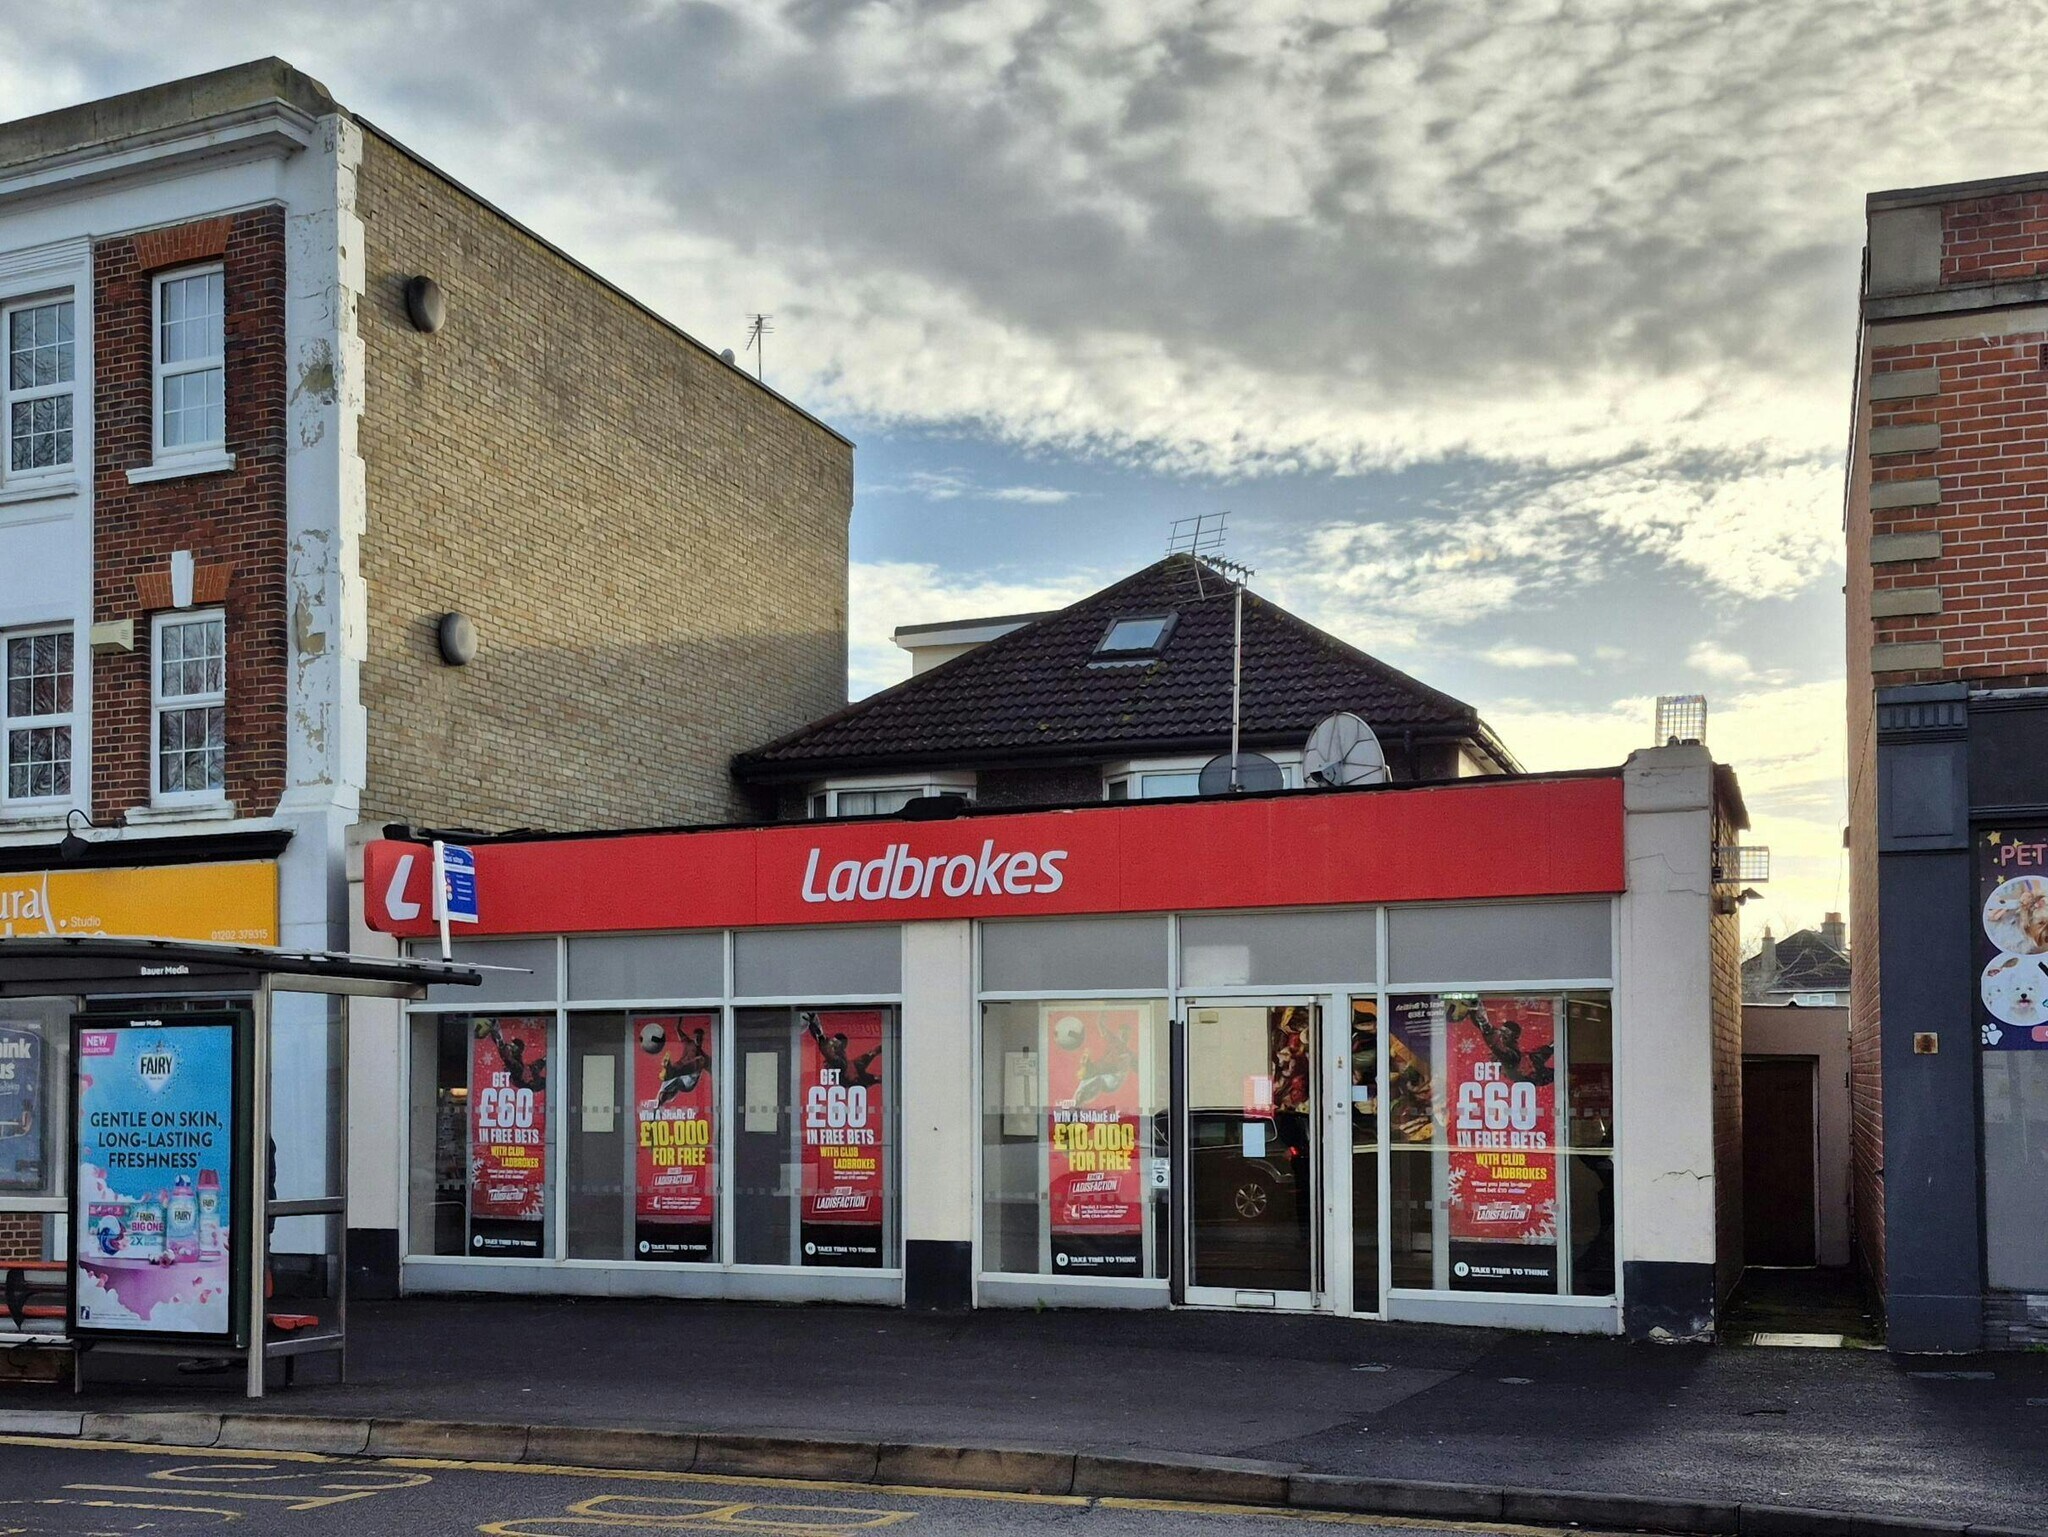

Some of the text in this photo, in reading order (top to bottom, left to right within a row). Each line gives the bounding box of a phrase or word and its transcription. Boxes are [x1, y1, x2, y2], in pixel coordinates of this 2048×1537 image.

[2001, 844, 2048, 866] PET
[801, 839, 1068, 903] Ladbrokes
[385, 855, 421, 920] L
[71, 915, 101, 928] Studio
[211, 930, 236, 940] 01202
[141, 965, 189, 976] Bauer Media
[0, 1038, 32, 1059] ink
[86, 1036, 108, 1046] NEW
[140, 1056, 172, 1075] FAIRY
[1474, 1062, 1502, 1081] GET
[492, 1071, 511, 1088] GET
[820, 1068, 841, 1086] GET
[479, 1087, 534, 1128] £60
[806, 1086, 867, 1128] £60
[1457, 1081, 1537, 1130] £60
[90, 1111, 223, 1131] GENTLE ON SKIN,
[1054, 1110, 1070, 1123] WIN
[1072, 1111, 1079, 1123] A
[98, 1132, 213, 1148] LONG-LASTING
[479, 1128, 539, 1144] IN FREE BETS
[640, 1120, 709, 1147] £10,000
[807, 1129, 874, 1145] IN FREE BETS
[1053, 1123, 1135, 1151] £10,000
[1457, 1131, 1546, 1149] IN FREE BETS
[491, 1145, 525, 1157] WITH CLUB
[653, 1147, 706, 1166] FOR FREE
[820, 1146, 859, 1157] WITH CLUB
[833, 1158, 875, 1170] LADBROKES
[1069, 1150, 1131, 1171] FOR FREE
[1475, 1153, 1526, 1168] WITH CLUB
[1492, 1166, 1547, 1180] LADBROKES
[816, 1195, 866, 1209] LADISFACTION
[174, 1210, 191, 1221] FAIRY
[131, 1222, 165, 1232] BIG ONE
[130, 1235, 144, 1246] 2X
[1470, 1266, 1490, 1274] TAKE
[1492, 1267, 1510, 1275] TIME
[1524, 1268, 1549, 1276] THINK
